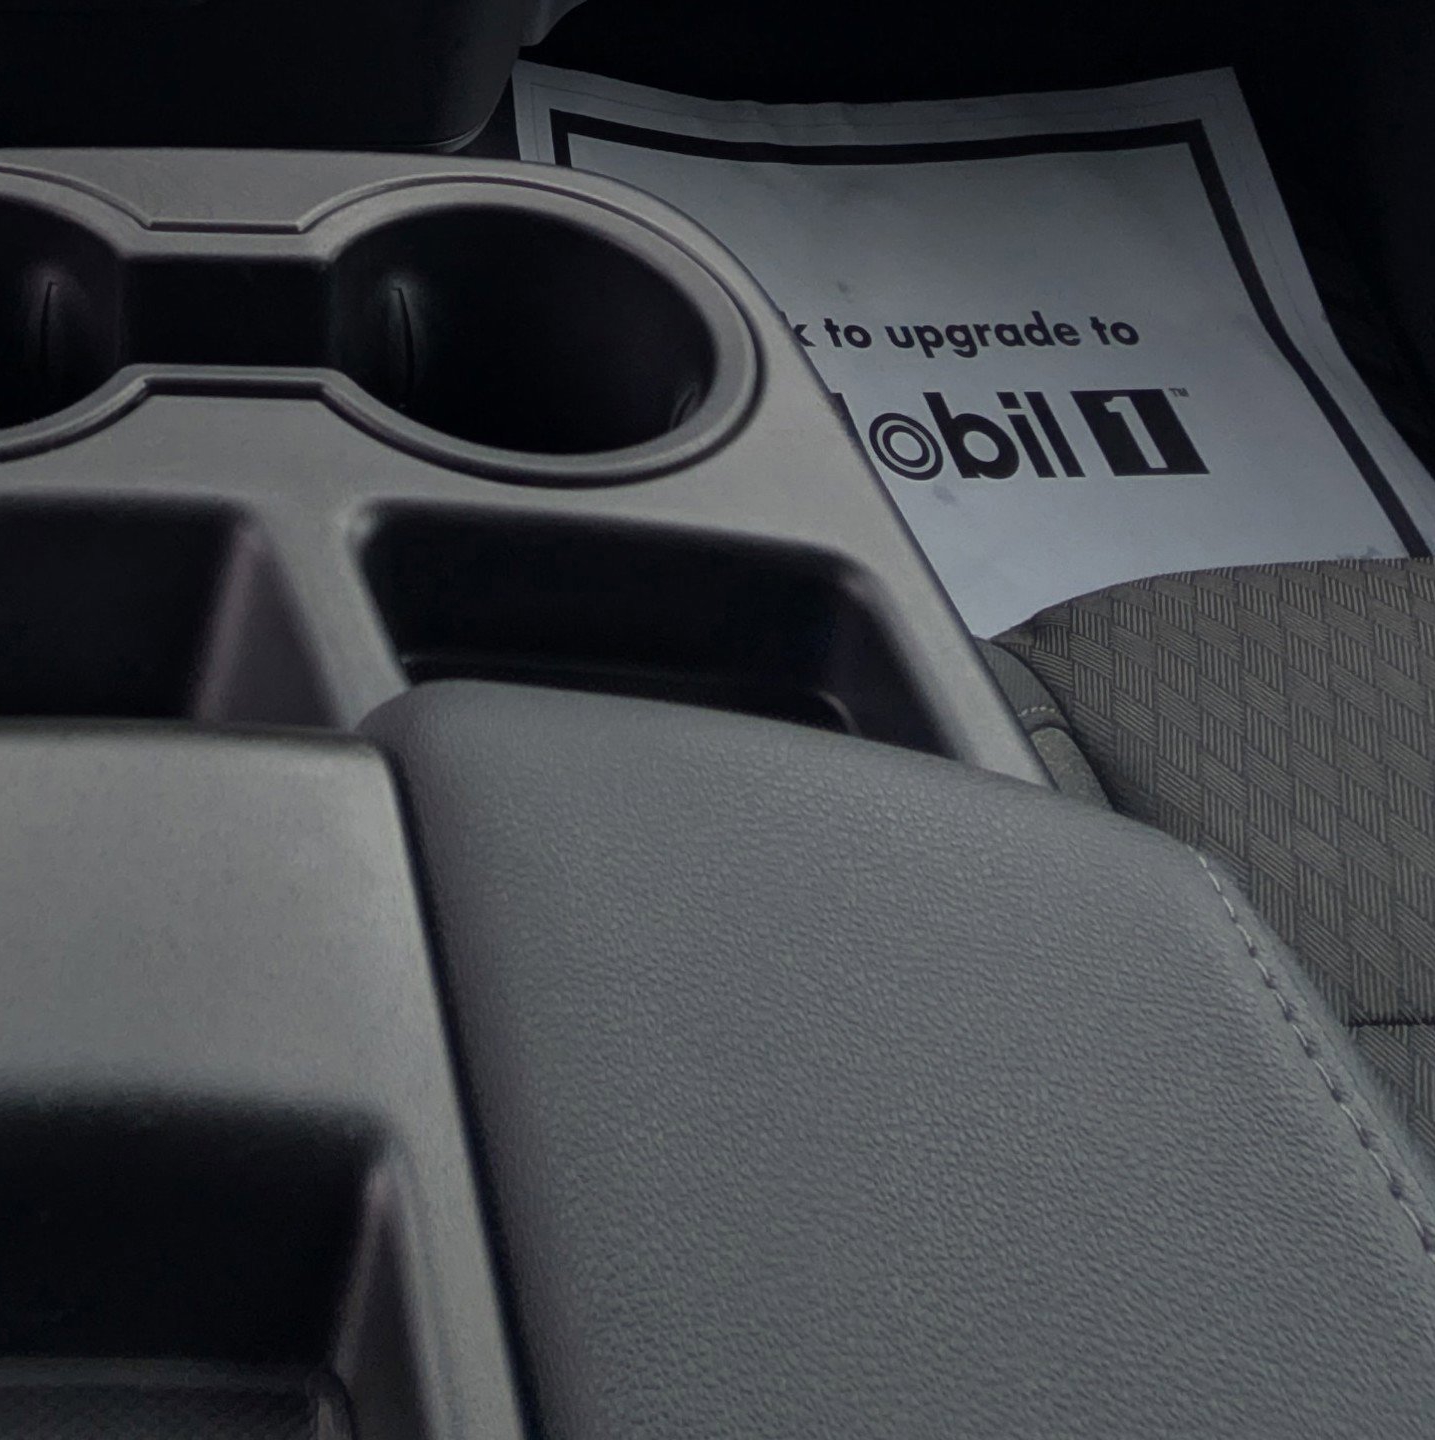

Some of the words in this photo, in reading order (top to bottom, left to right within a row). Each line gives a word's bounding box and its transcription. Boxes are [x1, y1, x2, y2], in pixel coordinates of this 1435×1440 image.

[824, 317, 872, 349] to
[885, 310, 1081, 359] upgrade
[1090, 315, 1140, 346] to
[831, 392, 1087, 481] obil
